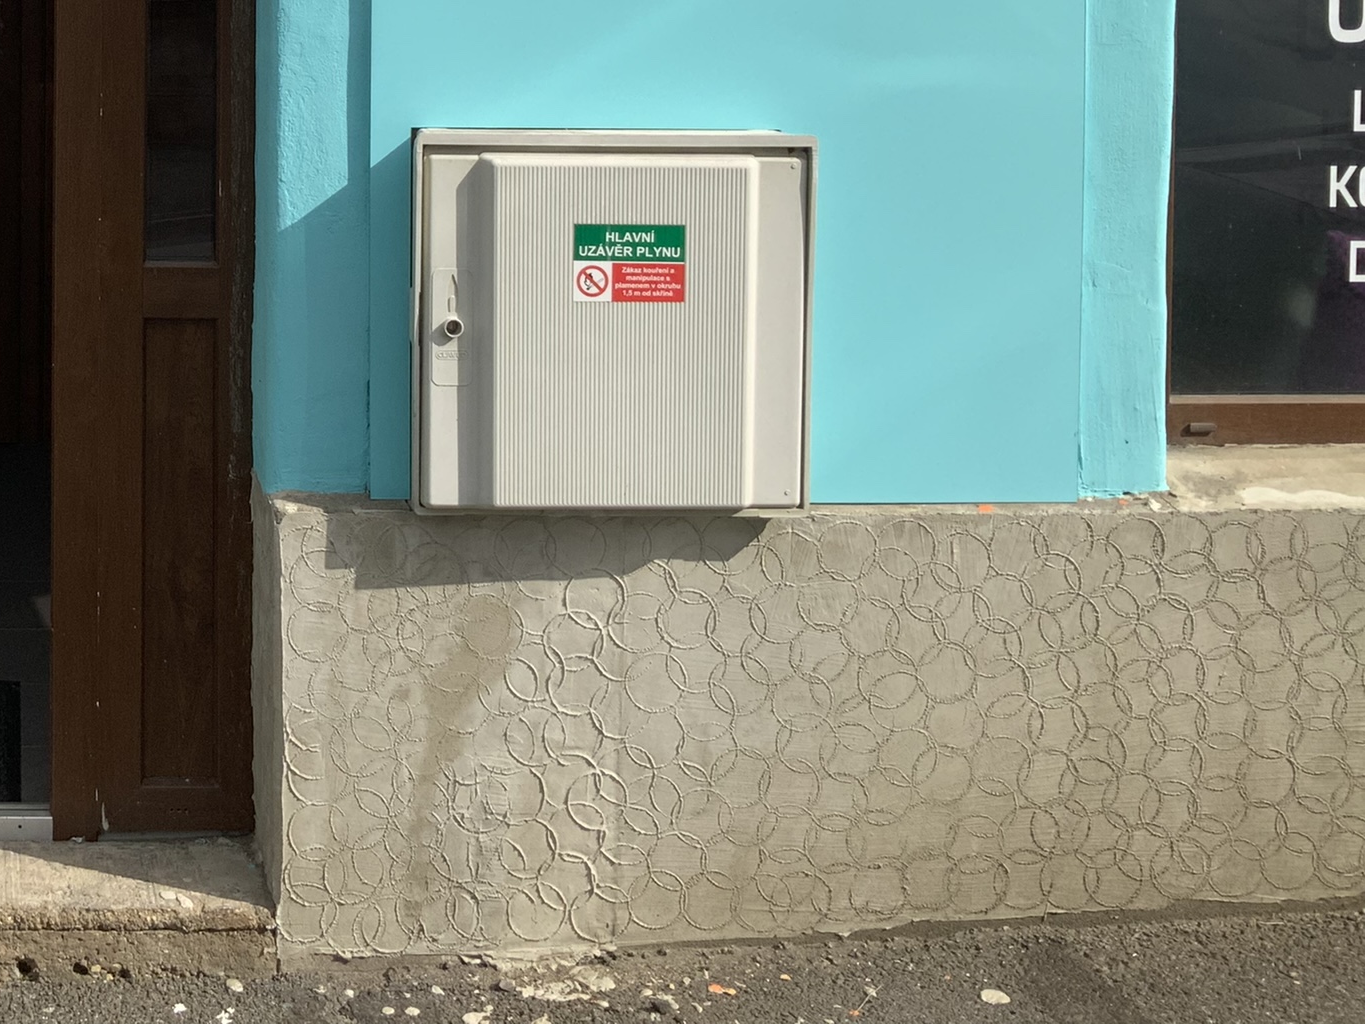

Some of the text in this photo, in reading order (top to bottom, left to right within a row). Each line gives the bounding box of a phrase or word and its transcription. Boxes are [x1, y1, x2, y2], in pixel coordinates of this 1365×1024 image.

[1329, 165, 1365, 208] K
[605, 230, 655, 243] HLAVNÍ
[579, 243, 681, 258] UZÁVĚR PLYNU
[621, 266, 642, 274] Zákaz
[643, 266, 669, 274] kouření
